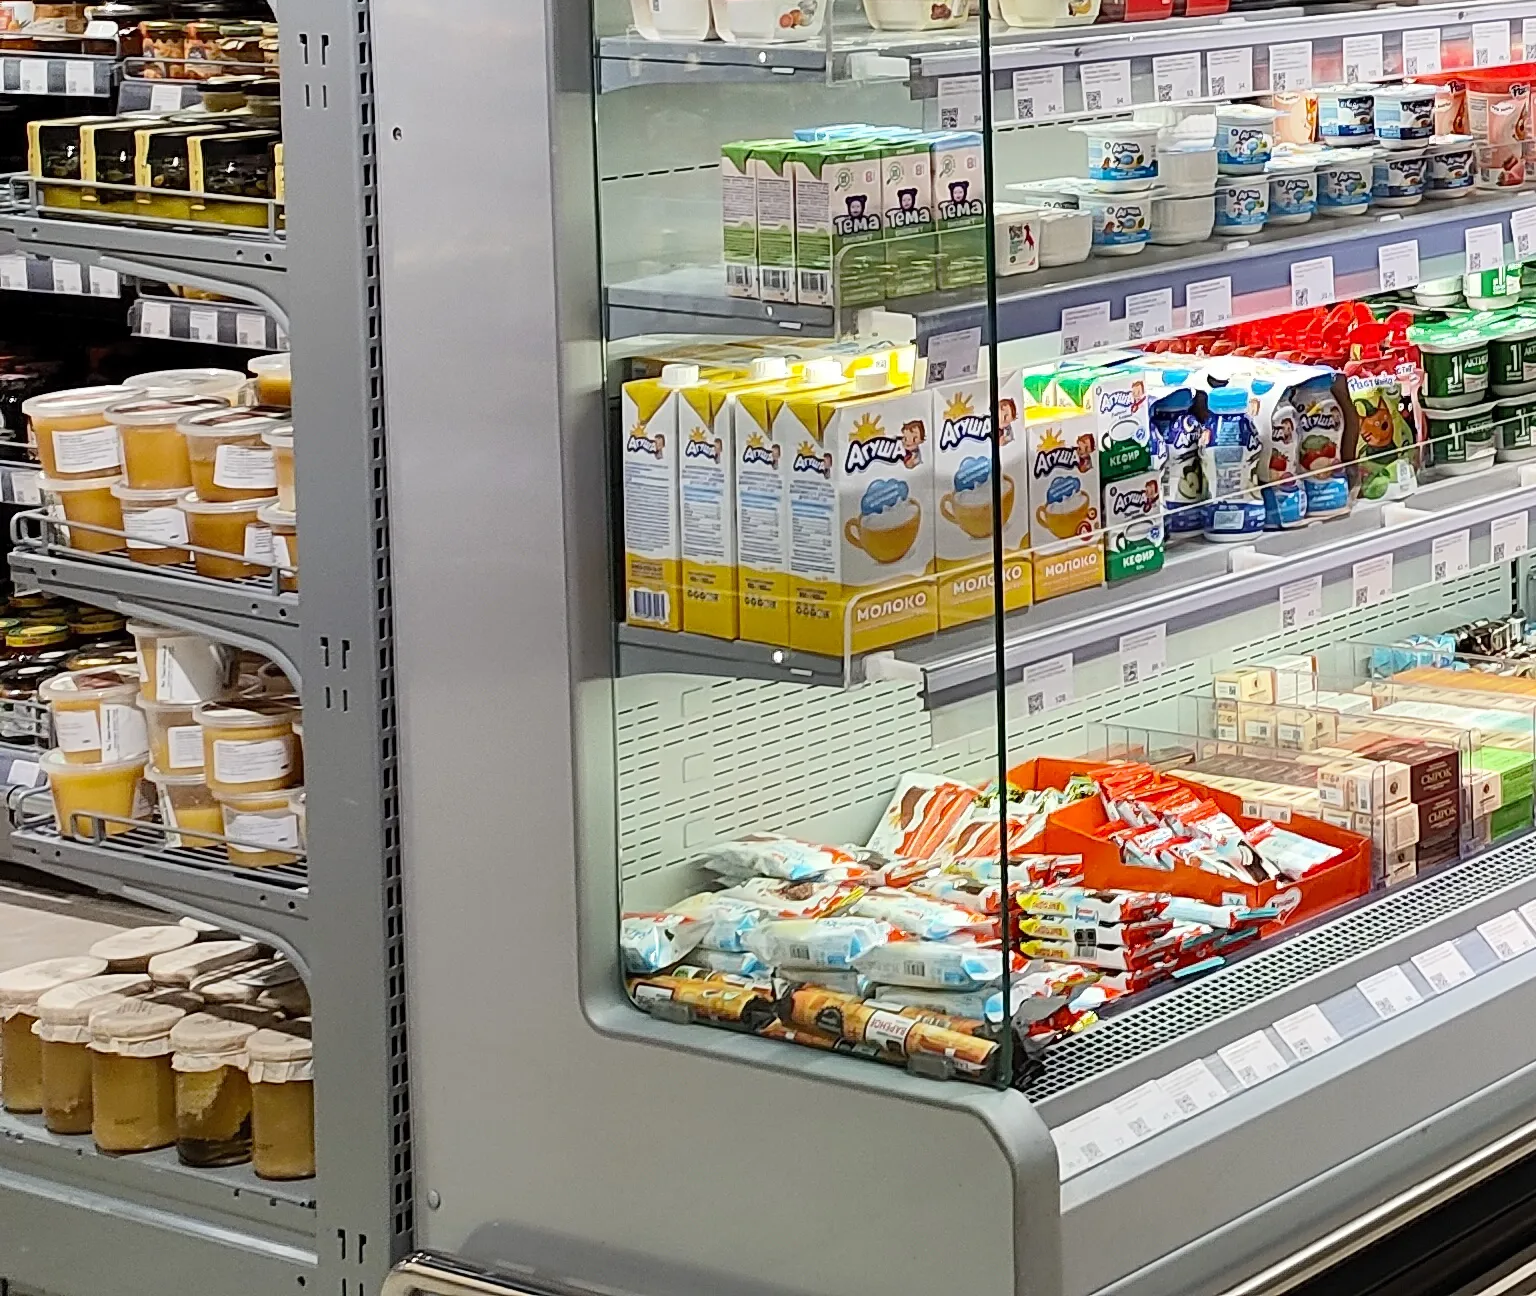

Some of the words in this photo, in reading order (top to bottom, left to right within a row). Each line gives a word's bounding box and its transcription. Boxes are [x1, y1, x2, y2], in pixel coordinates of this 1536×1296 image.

[1109, 449, 1141, 466] КЕФИР
[1045, 552, 1098, 577] МОЛОКО
[1122, 547, 1155, 568] КЕФИР
[857, 591, 928, 623] МОЛОКО
